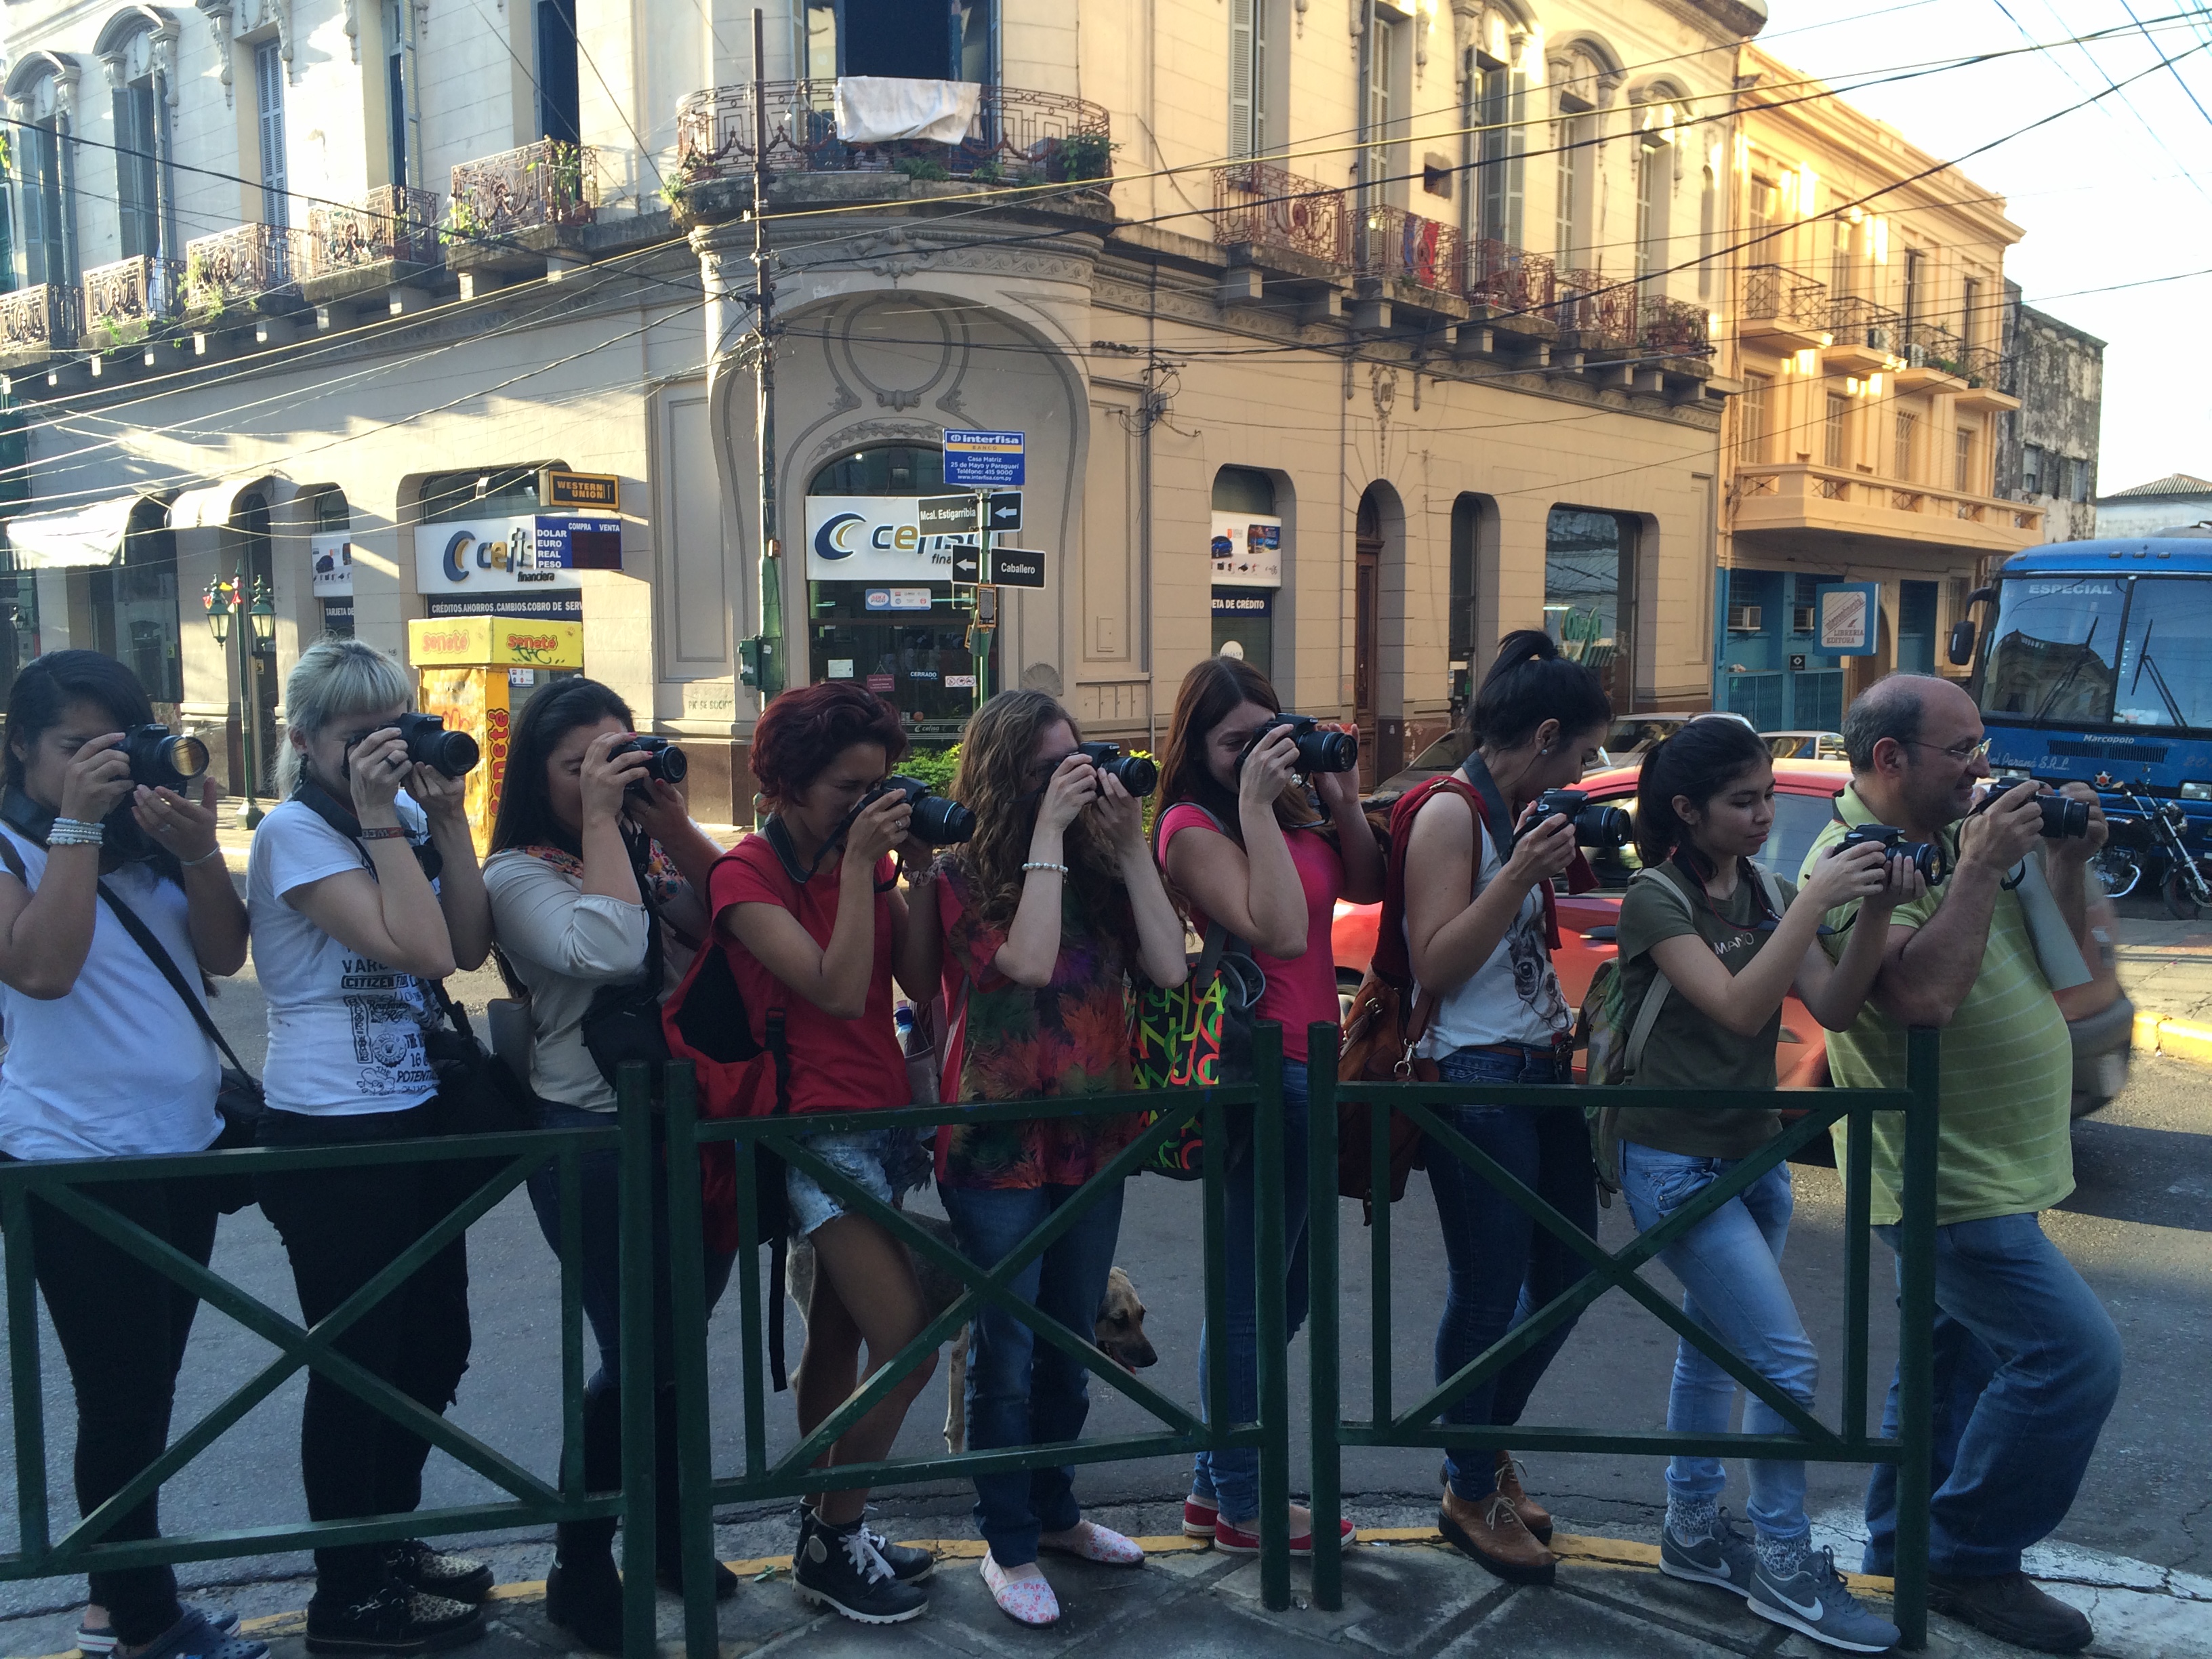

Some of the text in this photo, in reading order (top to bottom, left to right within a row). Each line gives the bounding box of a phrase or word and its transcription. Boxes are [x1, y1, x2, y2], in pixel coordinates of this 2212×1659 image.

[962, 434, 1019, 444] interfisa
[556, 480, 603, 491] WESTERN
[571, 489, 603, 499] UNION
[920, 507, 977, 521] Mcal. Estigarribia
[568, 523, 620, 532] COMPRA VENTA
[537, 529, 567, 537] DOLAR
[537, 539, 562, 548] EURO
[476, 527, 534, 573] cefis
[537, 550, 561, 558] REAL
[538, 560, 562, 569] PESO
[1001, 562, 1036, 575] Caballero
[517, 571, 555, 582] financiera
[2028, 583, 2113, 595] ESPECIAL
[552, 601, 562, 611] DE
[1225, 598, 1235, 609] DE
[1236, 596, 1265, 609] CRÉDITO
[325, 607, 347, 617] TARJETA
[2083, 735, 2135, 745] Marcopolo
[346, 977, 394, 988] CITIZEN
